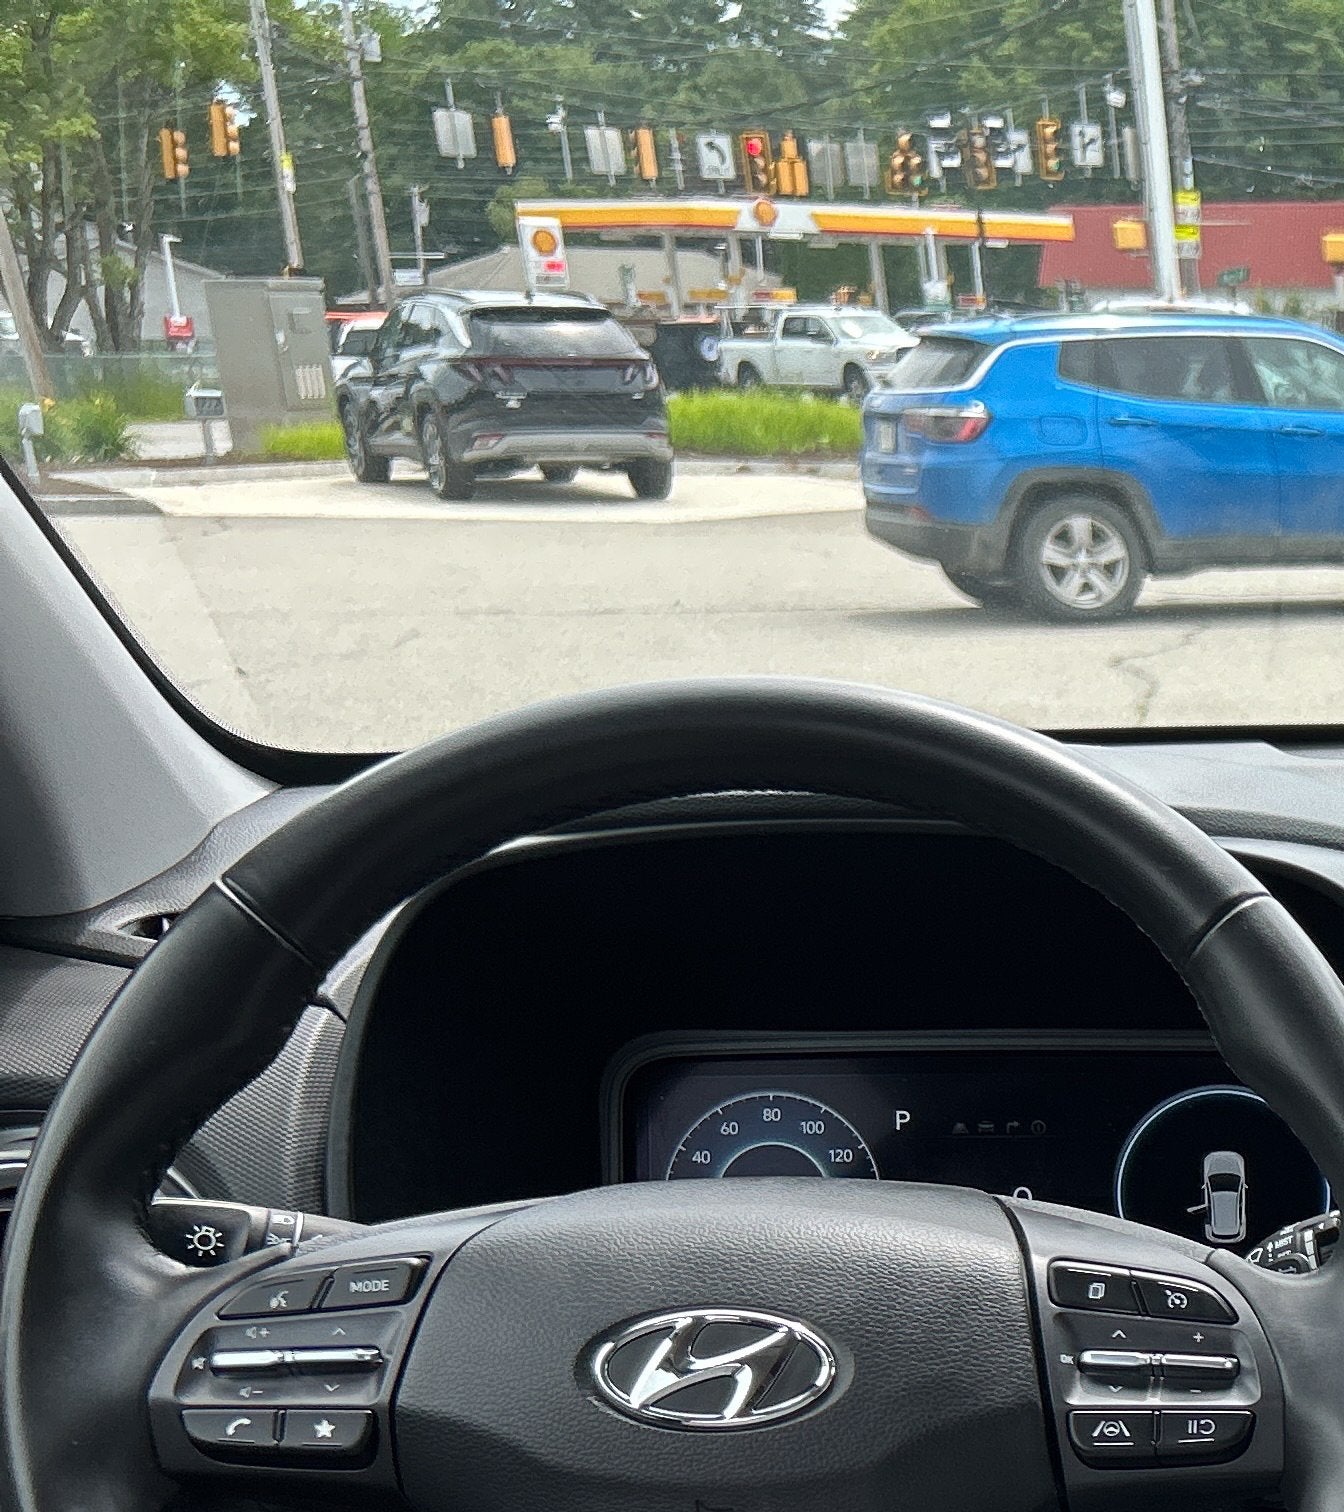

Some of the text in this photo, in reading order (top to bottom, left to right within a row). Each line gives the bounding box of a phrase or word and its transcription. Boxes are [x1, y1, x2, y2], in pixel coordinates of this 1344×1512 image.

[762, 1108, 781, 1122] 80
[895, 1110, 911, 1131] P
[720, 1122, 738, 1135] 60
[800, 1121, 825, 1135] 100
[692, 1151, 711, 1164] 40
[828, 1150, 853, 1163] 120
[351, 1280, 390, 1293] MODE
